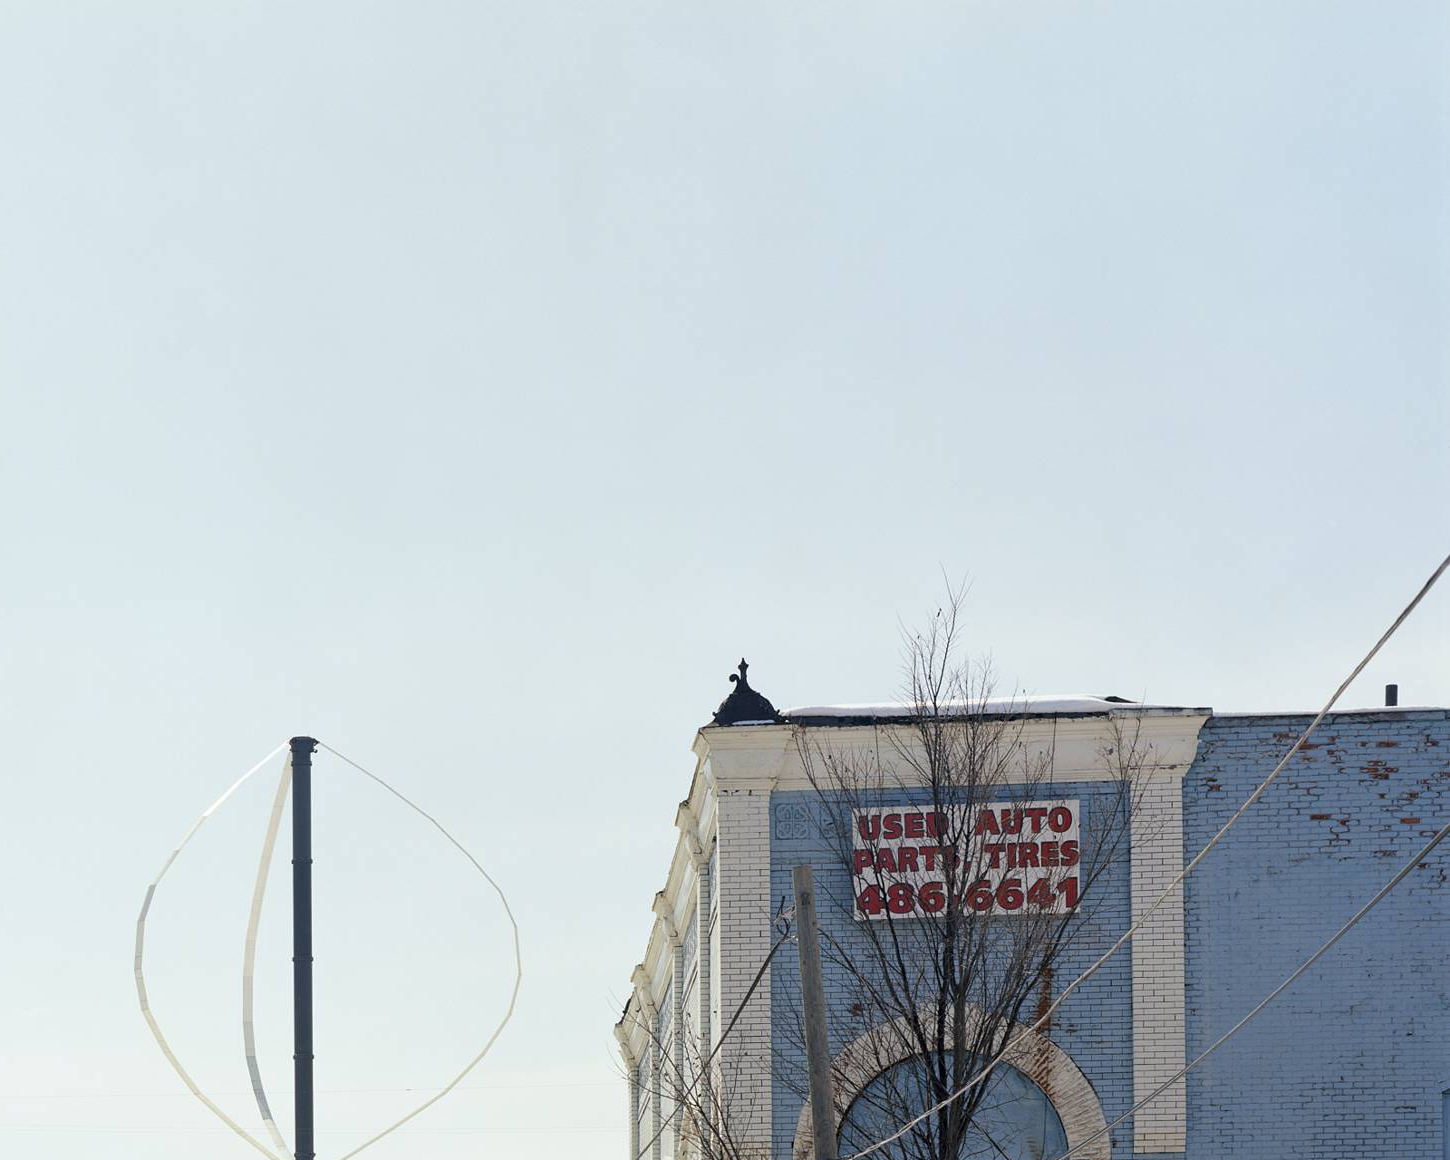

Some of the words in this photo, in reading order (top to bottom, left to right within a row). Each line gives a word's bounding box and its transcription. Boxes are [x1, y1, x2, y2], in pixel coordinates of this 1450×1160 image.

[858, 812, 950, 841] USED
[975, 806, 1073, 836] AUTO
[983, 840, 1080, 869] TIRES
